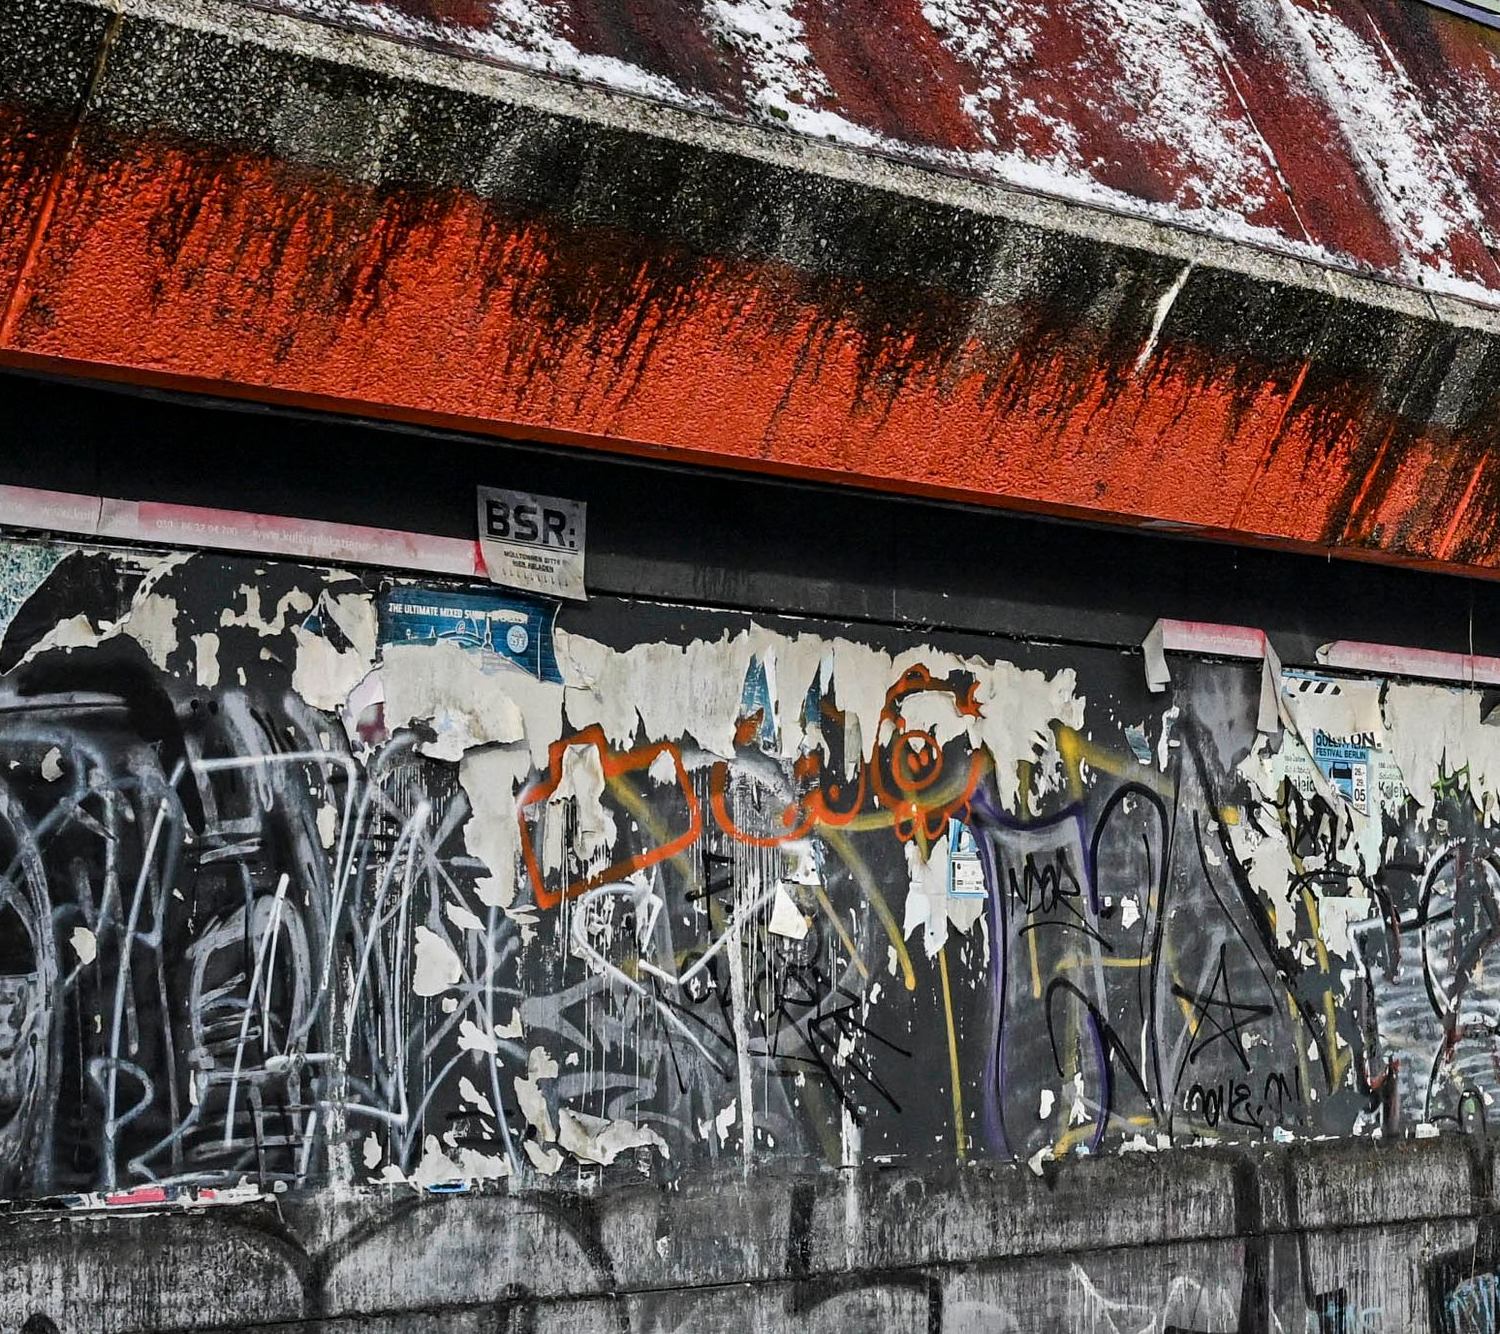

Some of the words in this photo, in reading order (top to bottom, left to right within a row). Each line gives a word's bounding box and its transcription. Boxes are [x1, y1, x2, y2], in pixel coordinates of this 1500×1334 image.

[404, 605, 439, 617] ULTIMATE
[439, 607, 463, 619] MIXED
[1315, 747, 1343, 758] FESTIVAL
[1344, 750, 1367, 760] BERLIN
[1354, 788, 1366, 803] 05
